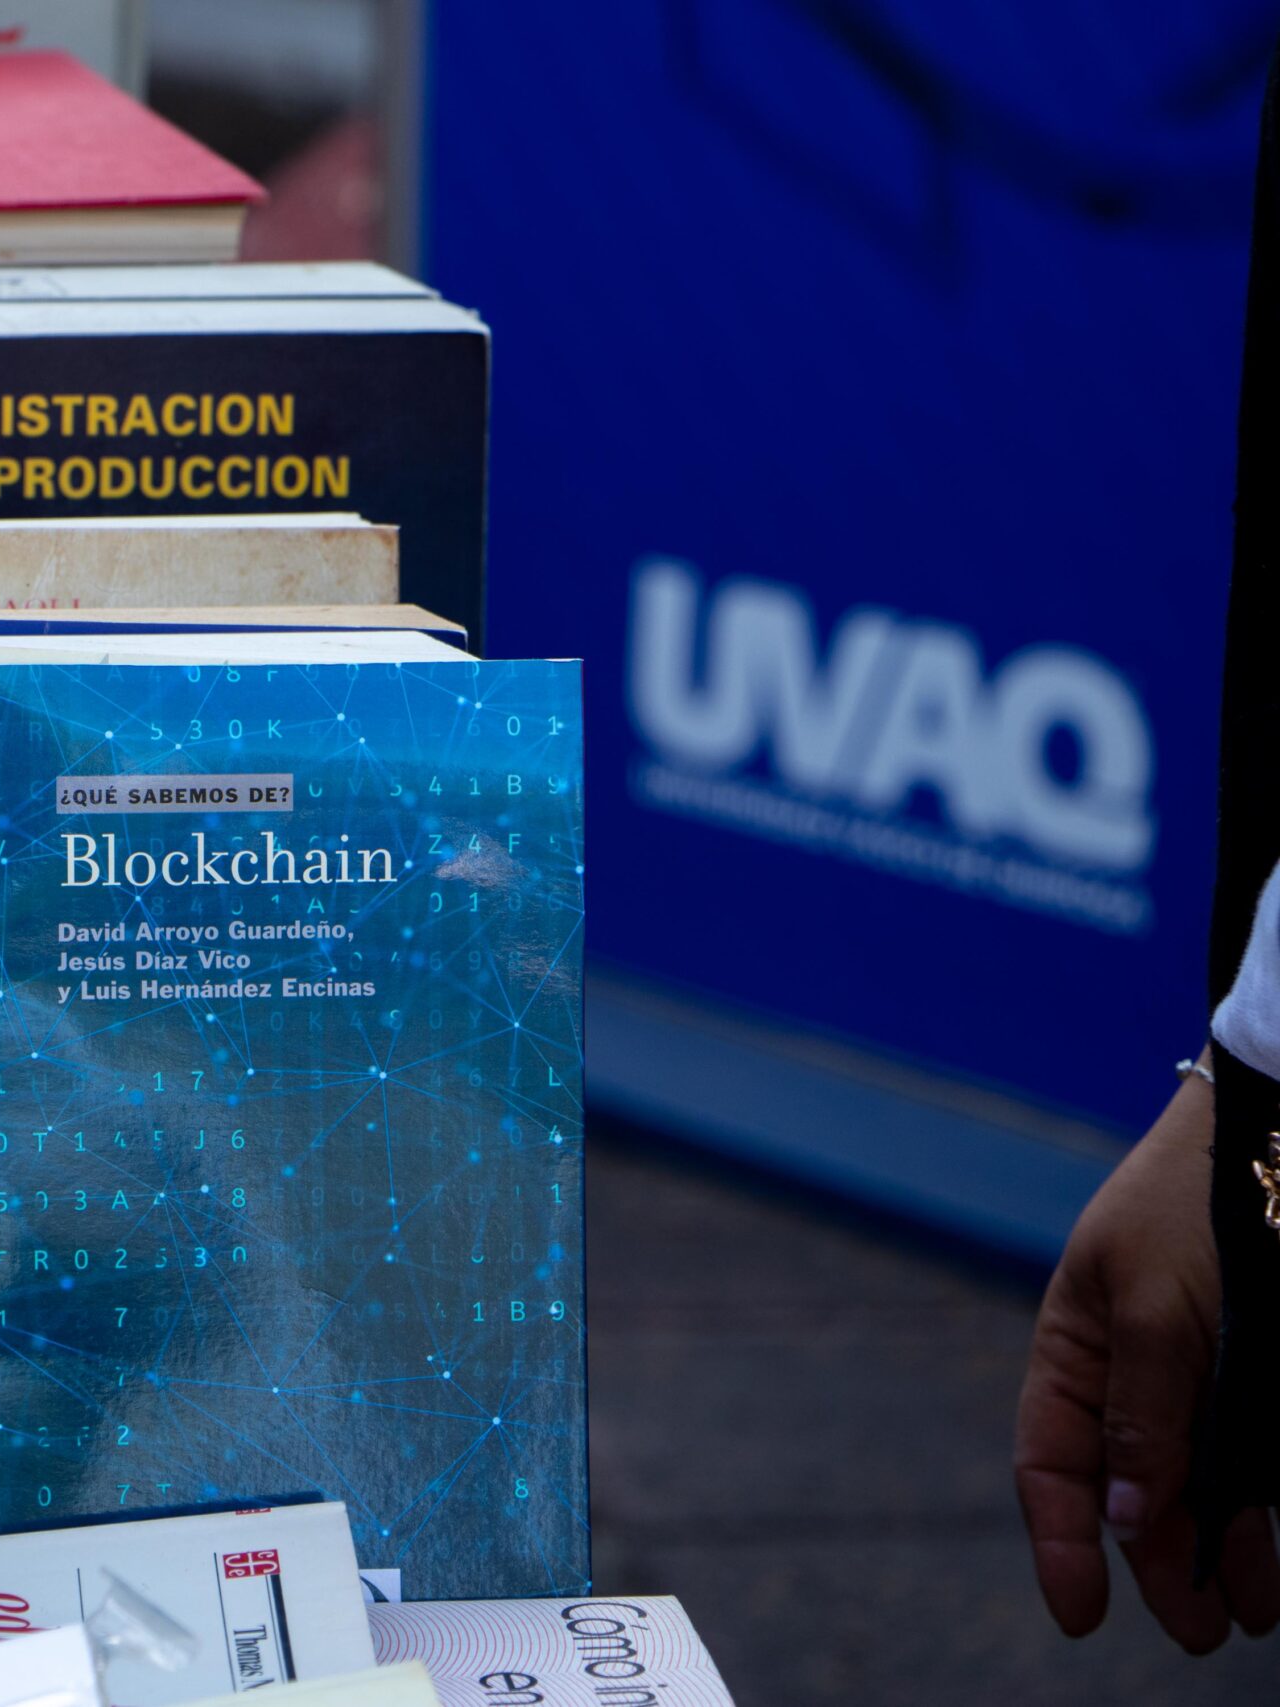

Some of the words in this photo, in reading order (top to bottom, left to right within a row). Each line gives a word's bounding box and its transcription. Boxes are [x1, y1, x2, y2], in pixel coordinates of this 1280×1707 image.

[60, 786, 118, 805] ¿QUÉ
[128, 787, 239, 804] SABEMOS
[249, 787, 290, 803] DE?
[60, 832, 398, 887] Blockchain
[58, 923, 126, 942] David
[135, 921, 219, 944] Arroyo
[228, 919, 354, 943] Guardeño,
[57, 951, 126, 972] Jesús
[136, 951, 187, 971] Díaz
[198, 950, 251, 970] Vico
[58, 985, 71, 1004] y
[81, 980, 131, 1001] Luis
[141, 979, 271, 1000] Hernández
[282, 977, 376, 998] Encinas
[233, 1624, 268, 1678] Thomas
[561, 1602, 649, 1679] Cómo
